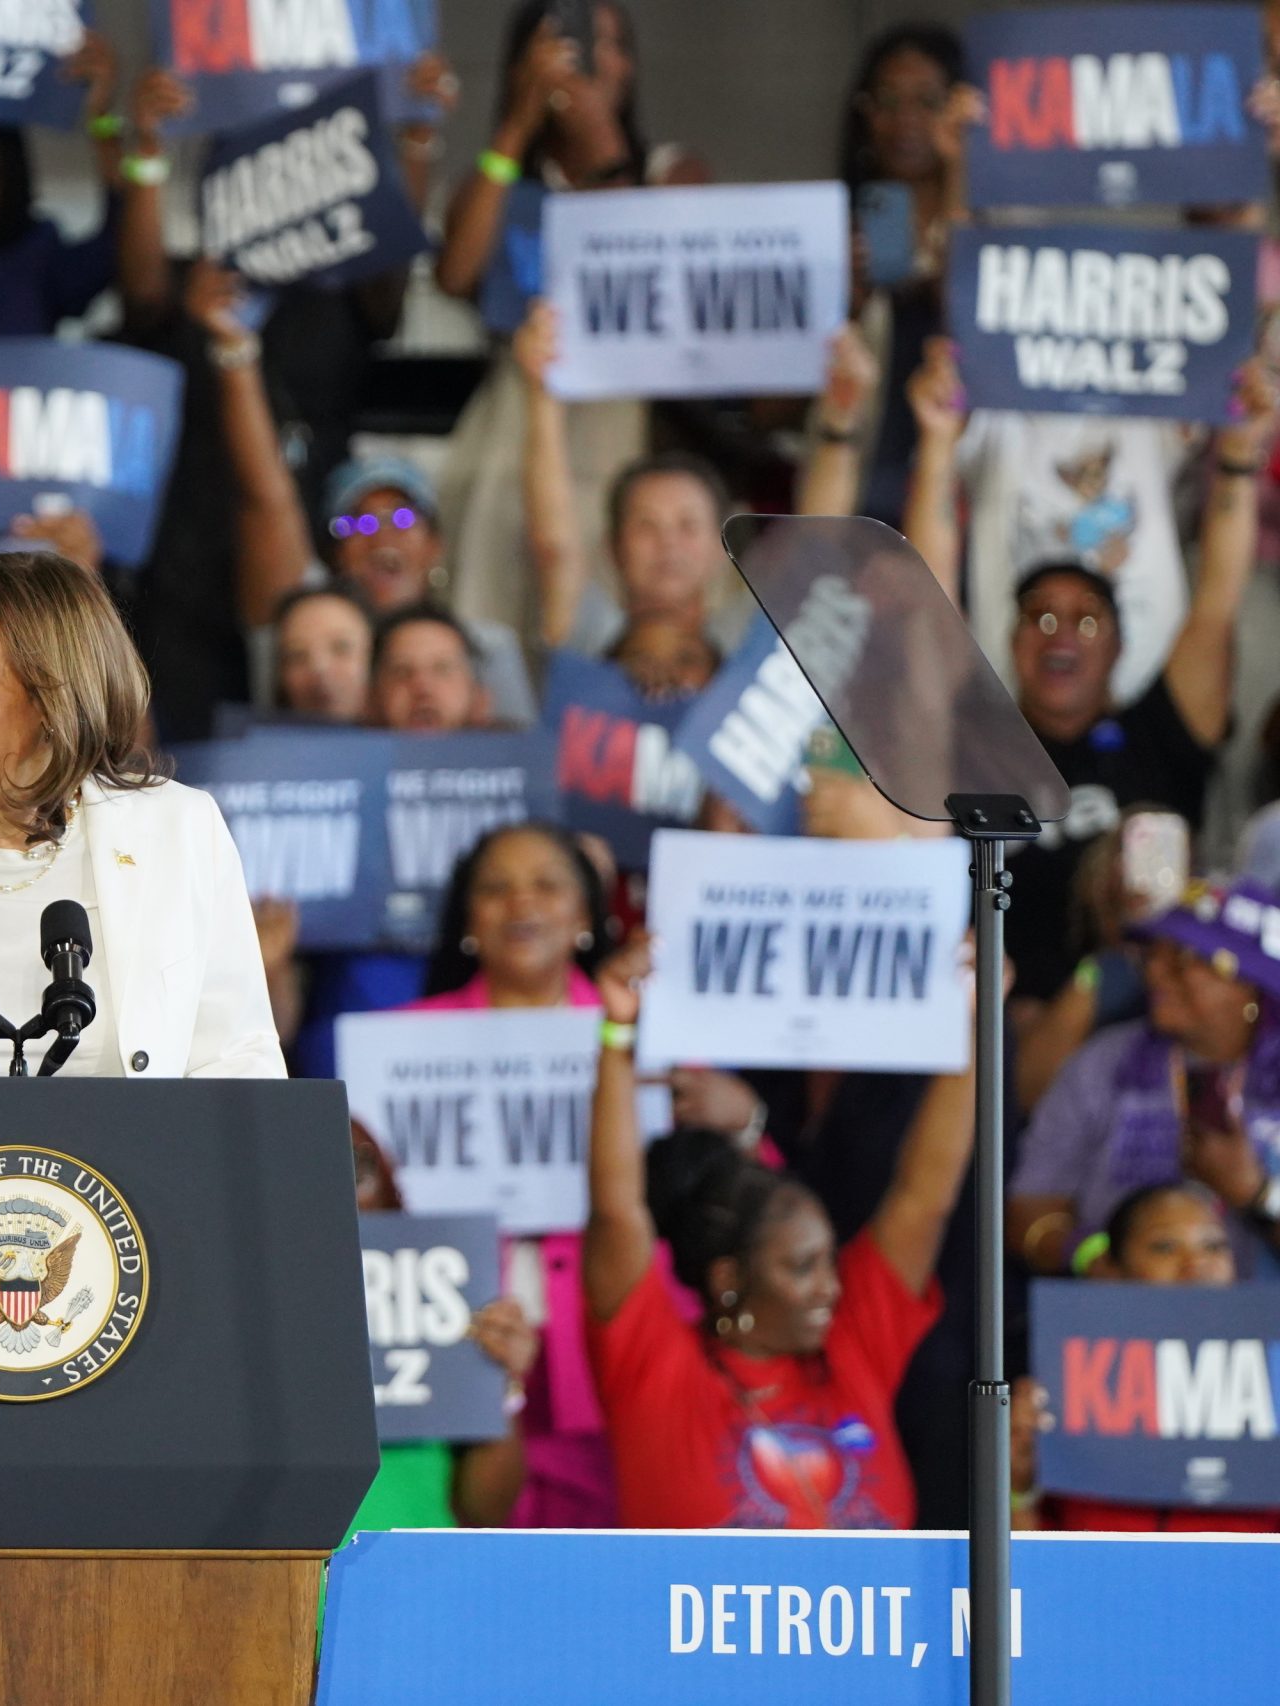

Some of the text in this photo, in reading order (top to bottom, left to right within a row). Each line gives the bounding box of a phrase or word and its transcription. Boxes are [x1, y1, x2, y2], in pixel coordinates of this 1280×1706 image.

[988, 52, 1245, 150] KAMALA
[202, 106, 379, 260] HARRIS
[579, 262, 808, 334] WE WIN
[976, 245, 1232, 345] HARRIS
[1014, 334, 1188, 396] WALZ
[702, 885, 792, 908] WHEN
[803, 887, 846, 909] WE
[691, 918, 935, 1000] WE WIN
[18, 1156, 62, 1180] THE
[384, 1092, 477, 1168] WE
[29, 1238, 50, 1247] UNUM
[73, 1171, 141, 1275] UNITED
[62, 1292, 139, 1383] STATES
[1062, 1336, 1280, 1441] KAMA
[669, 1583, 929, 1668] DETROIT,
